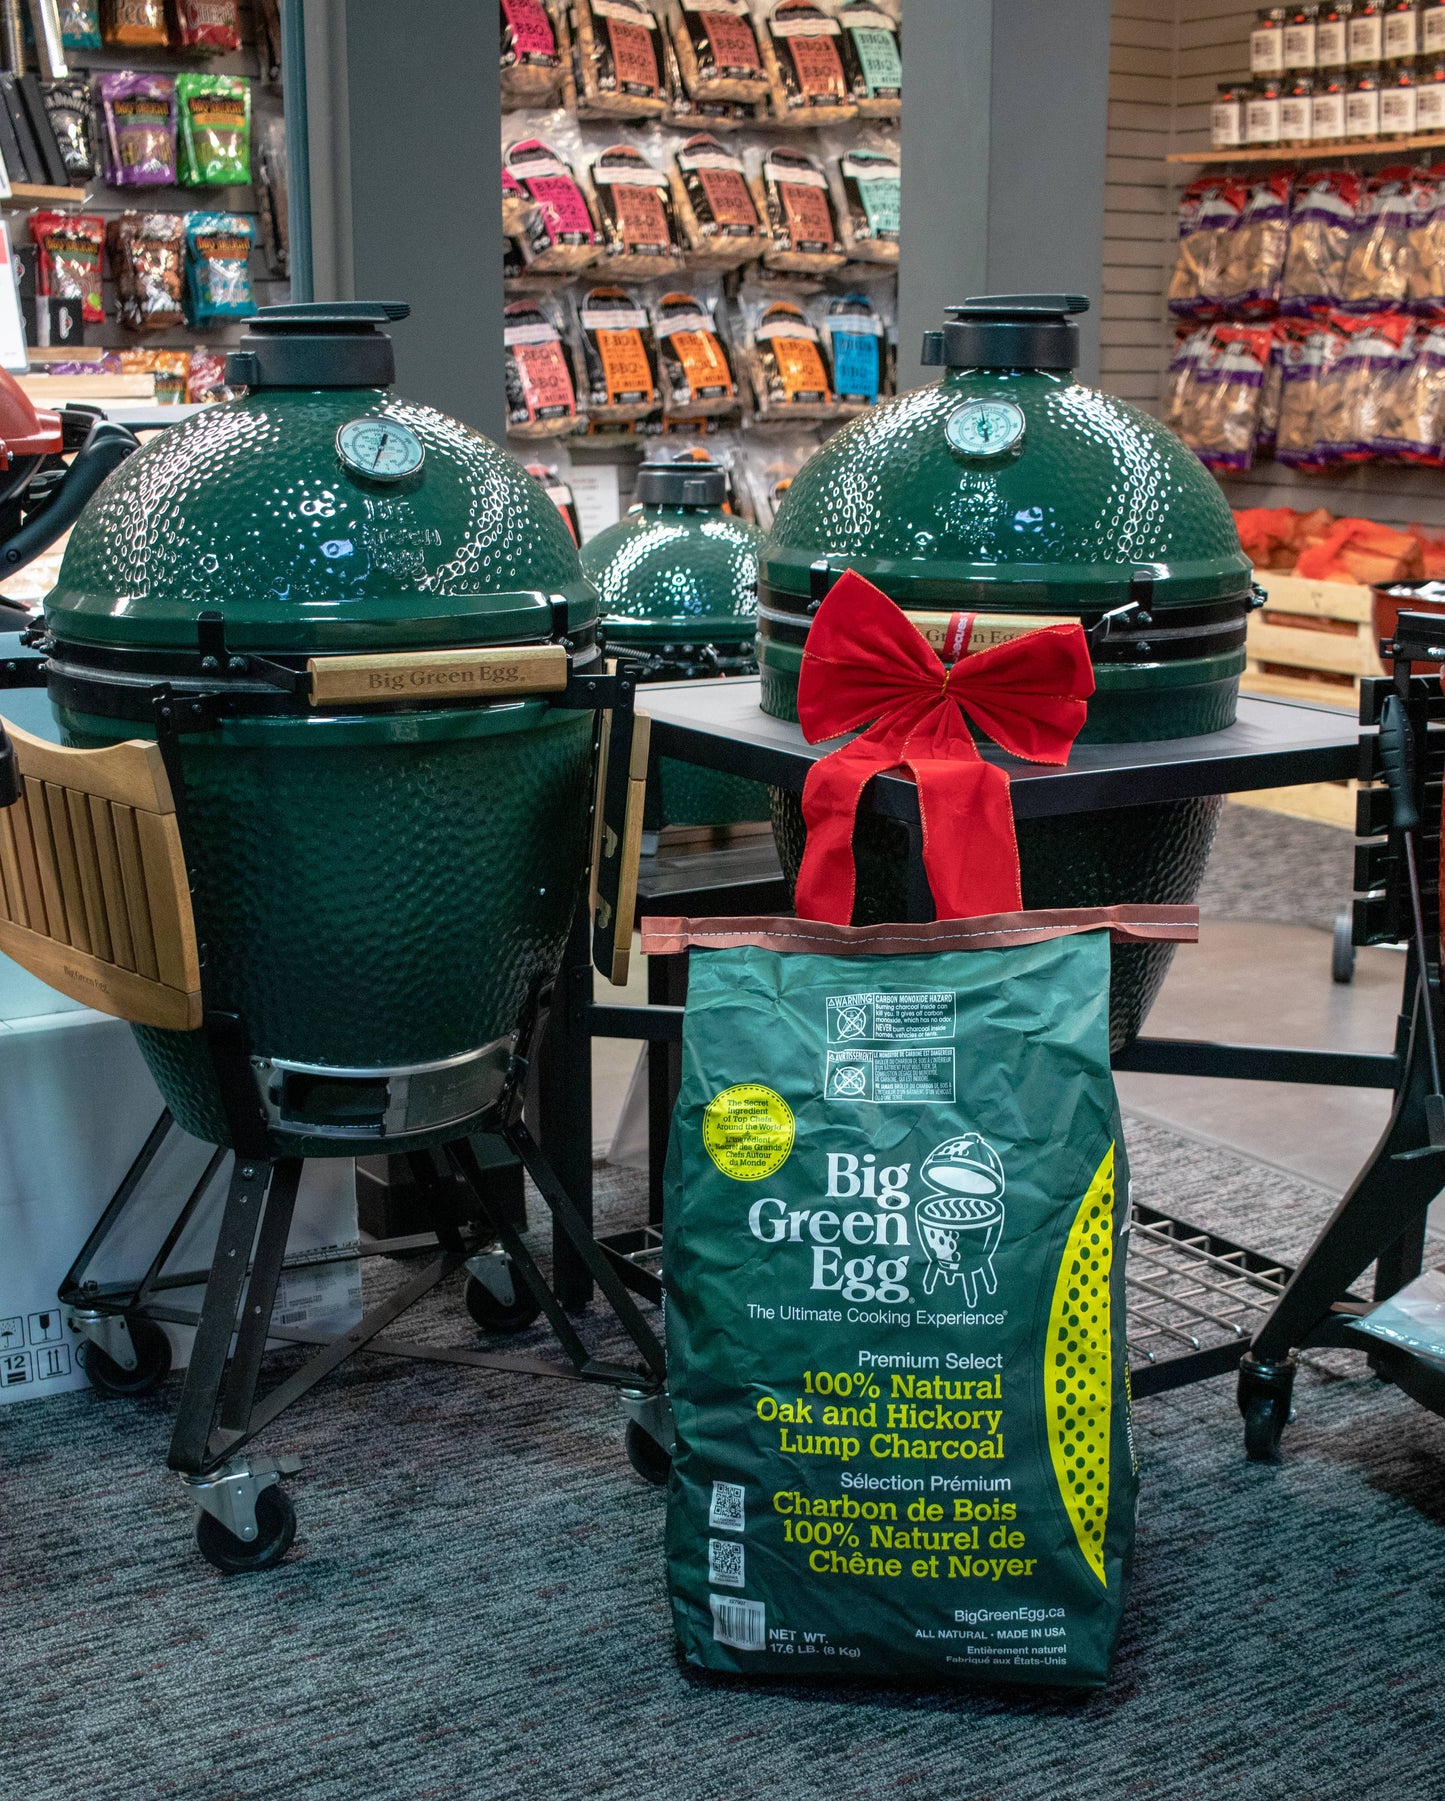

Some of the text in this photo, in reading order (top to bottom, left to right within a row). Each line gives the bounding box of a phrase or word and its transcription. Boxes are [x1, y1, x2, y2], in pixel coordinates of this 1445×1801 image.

[926, 629, 984, 643] Grn
[368, 674, 404, 690] Big
[410, 669, 474, 686] Green
[834, 994, 872, 1006] WARNING
[876, 994, 953, 1003] CARBON MONOXIDE HAZARD
[876, 1024, 892, 1032] NEVER
[825, 1152, 911, 1210] Big
[748, 1198, 911, 1246] Green
[747, 1304, 775, 1320] The
[780, 1305, 842, 1322] Ultimate
[847, 1308, 911, 1328] Cooking
[4, 1356, 26, 1370] 12
[858, 1350, 1002, 1370] Premium Select
[803, 1371, 1002, 1399] 100% Natural
[756, 1397, 1002, 1435] Oak and Hickory
[780, 1428, 1004, 1461] Lump Charcoal
[840, 1472, 1012, 1492] Sélection Prémium
[772, 1491, 1017, 1522] Charbon de Bois
[784, 1520, 1026, 1550] 100% Naturel de
[808, 1550, 1038, 1582] Chêne et Noyer
[954, 1607, 1066, 1624] BigGreenEgg.ca
[770, 1628, 796, 1641] NET
[804, 1632, 829, 1644] WT.
[916, 1626, 1066, 1640] ALL NATURAL MADE IN USA
[770, 1644, 861, 1658] 17.6 LB. (8 Kg)
[968, 1644, 1067, 1654] Entièrement naturel
[946, 1656, 990, 1664] Fabriqué
[1014, 1655, 1067, 1666] États-Unis
